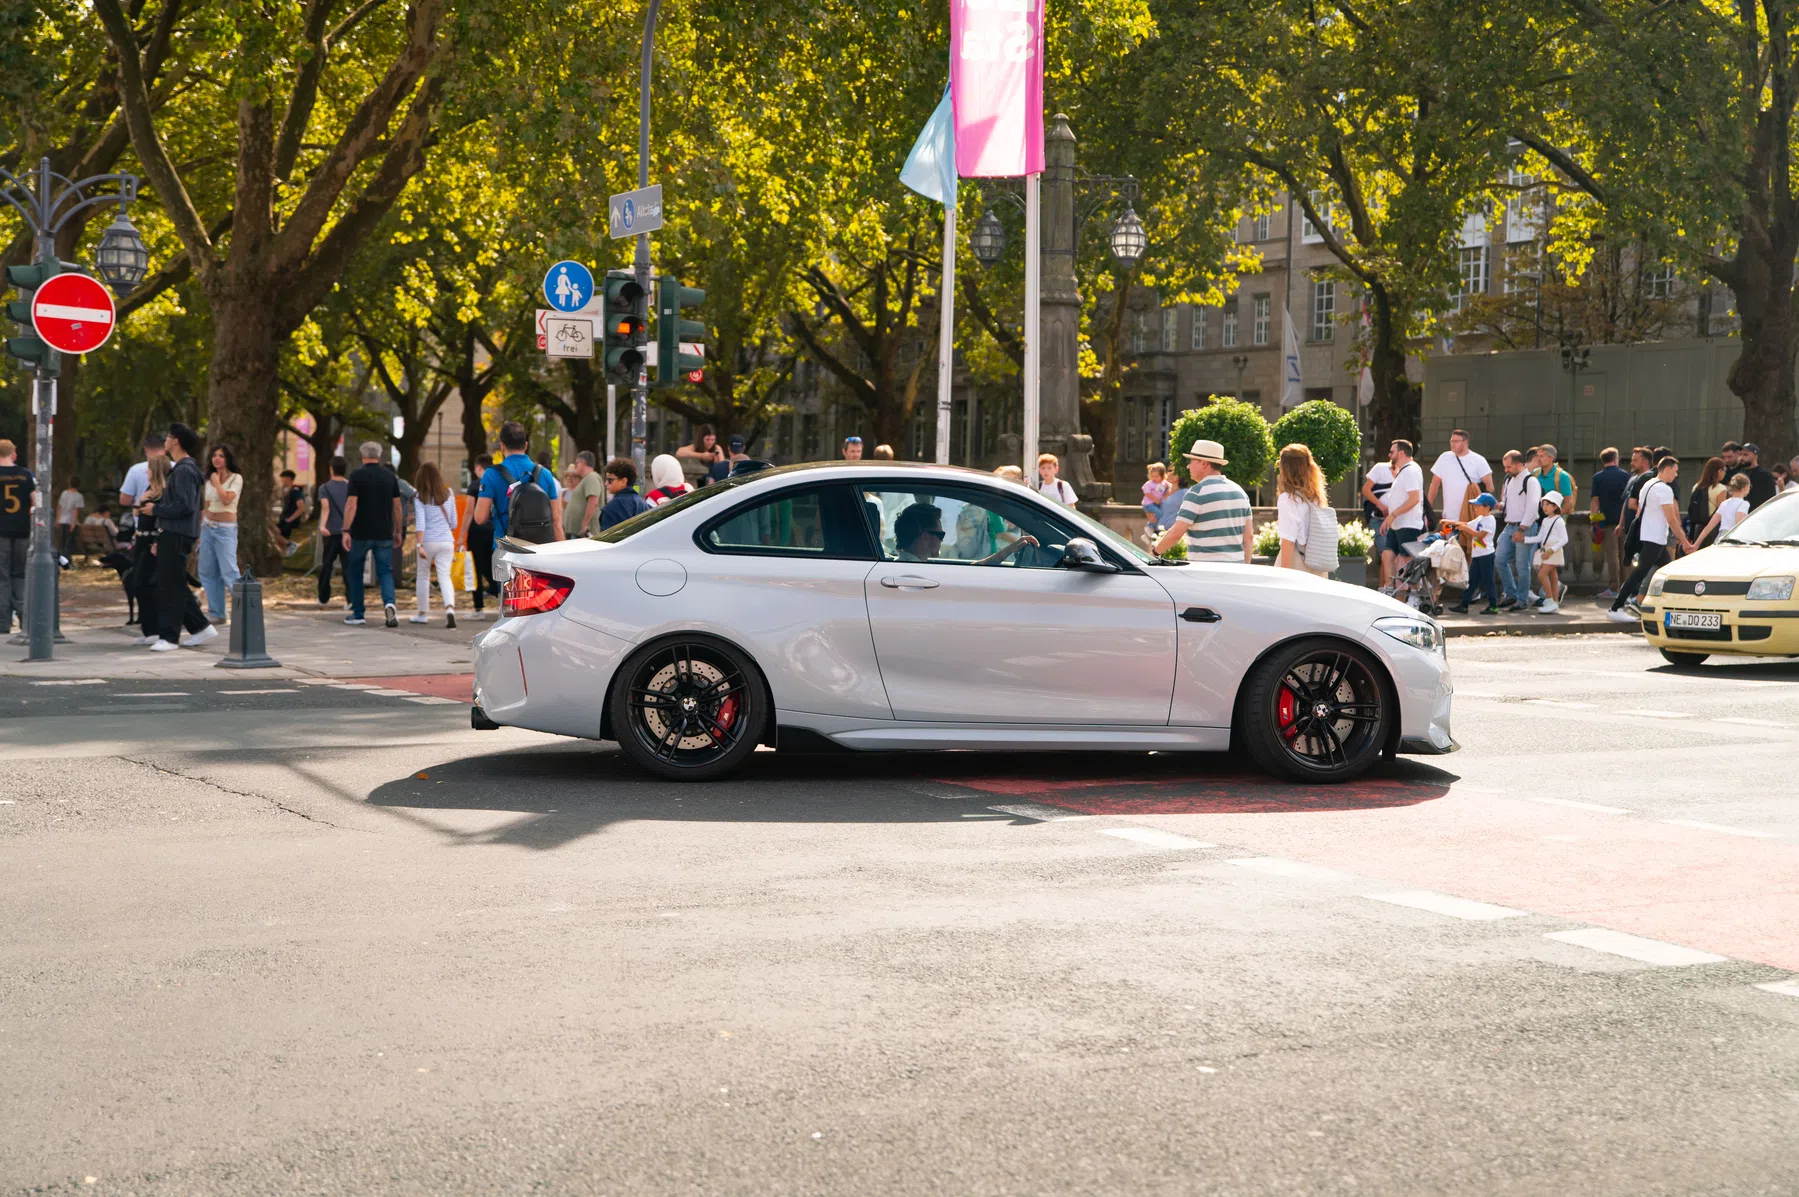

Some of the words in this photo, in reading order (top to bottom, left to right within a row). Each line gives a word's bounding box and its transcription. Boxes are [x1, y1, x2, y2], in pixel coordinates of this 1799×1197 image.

[563, 344, 578, 353] frei
[4, 484, 21, 514] 5
[1670, 614, 1682, 625] NE
[1701, 615, 1719, 627] 233
